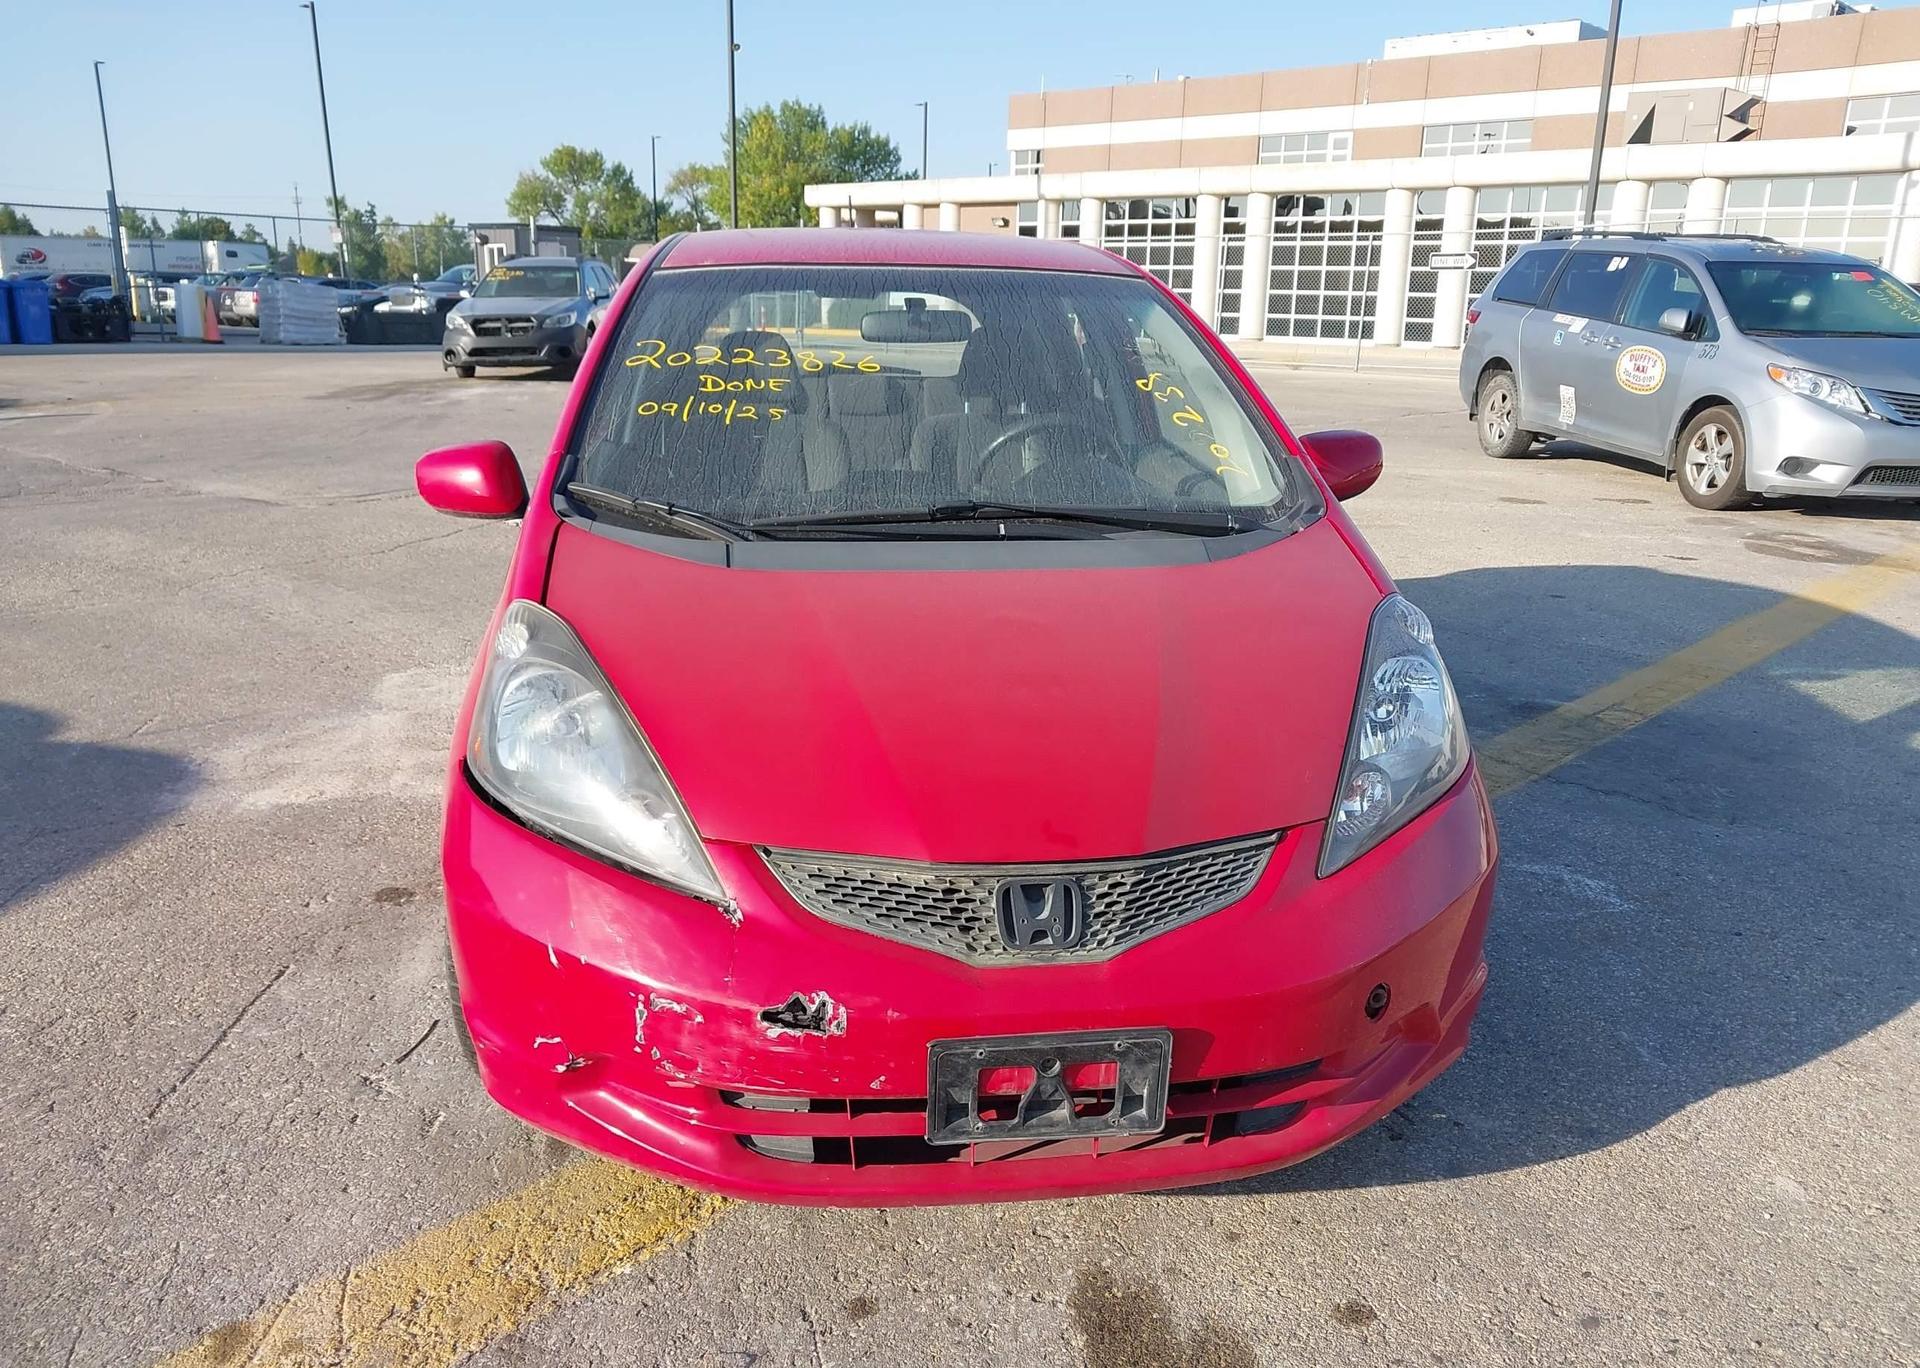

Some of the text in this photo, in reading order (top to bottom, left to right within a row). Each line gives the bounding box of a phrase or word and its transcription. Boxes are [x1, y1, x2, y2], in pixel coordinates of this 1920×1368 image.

[1433, 257, 1469, 265] ONE WAY
[624, 340, 881, 372] 20223826
[1629, 352, 1658, 368] DUFFY'S
[1697, 344, 1720, 360] 573
[1633, 362, 1649, 374] TAXI
[699, 375, 791, 393] DONE
[637, 395, 789, 425] 09/10/25
